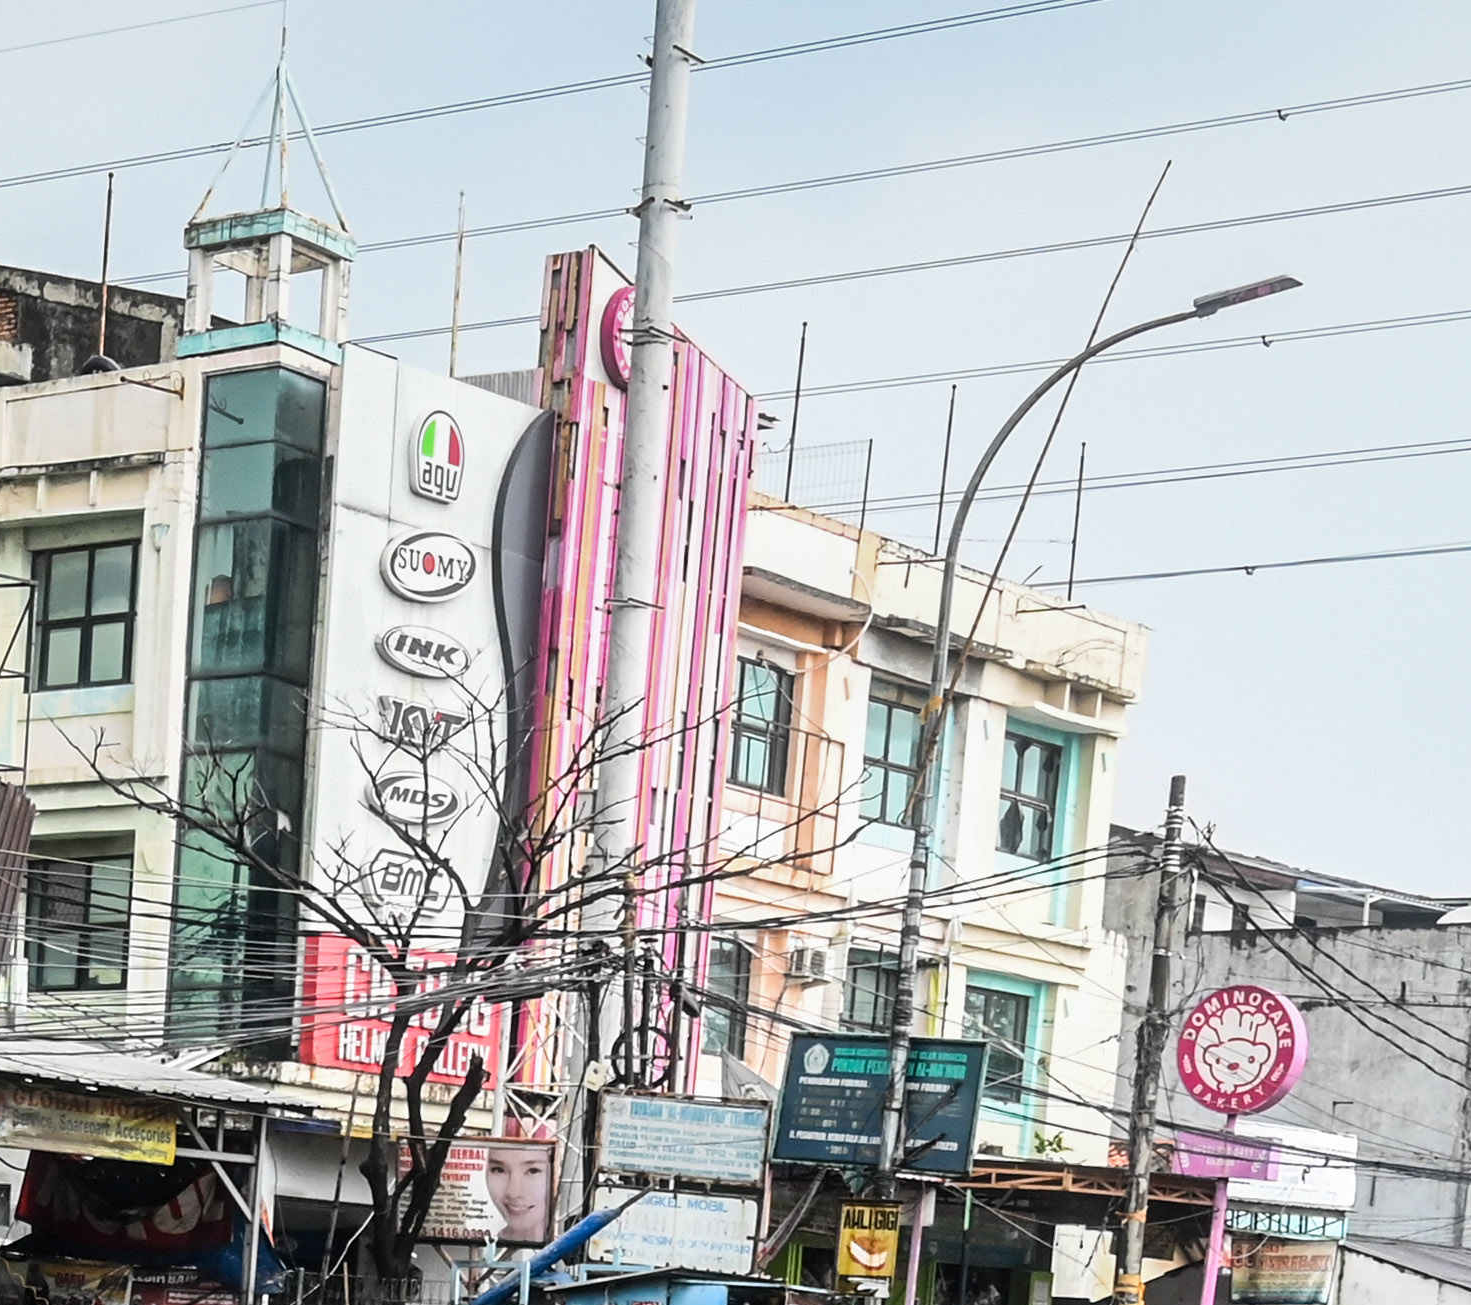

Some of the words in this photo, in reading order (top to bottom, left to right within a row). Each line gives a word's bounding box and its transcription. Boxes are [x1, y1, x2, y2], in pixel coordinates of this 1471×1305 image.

[398, 547, 469, 582] SUOMY
[394, 634, 460, 665] INK
[389, 786, 448, 808] MDS
[1183, 990, 1292, 1049] DOMINOCAKE
[1192, 1084, 1267, 1109] BAKERY
[687, 1199, 729, 1213] MOBIL
[844, 1209, 872, 1230] AHLI
[874, 1210, 900, 1231] GIGI
